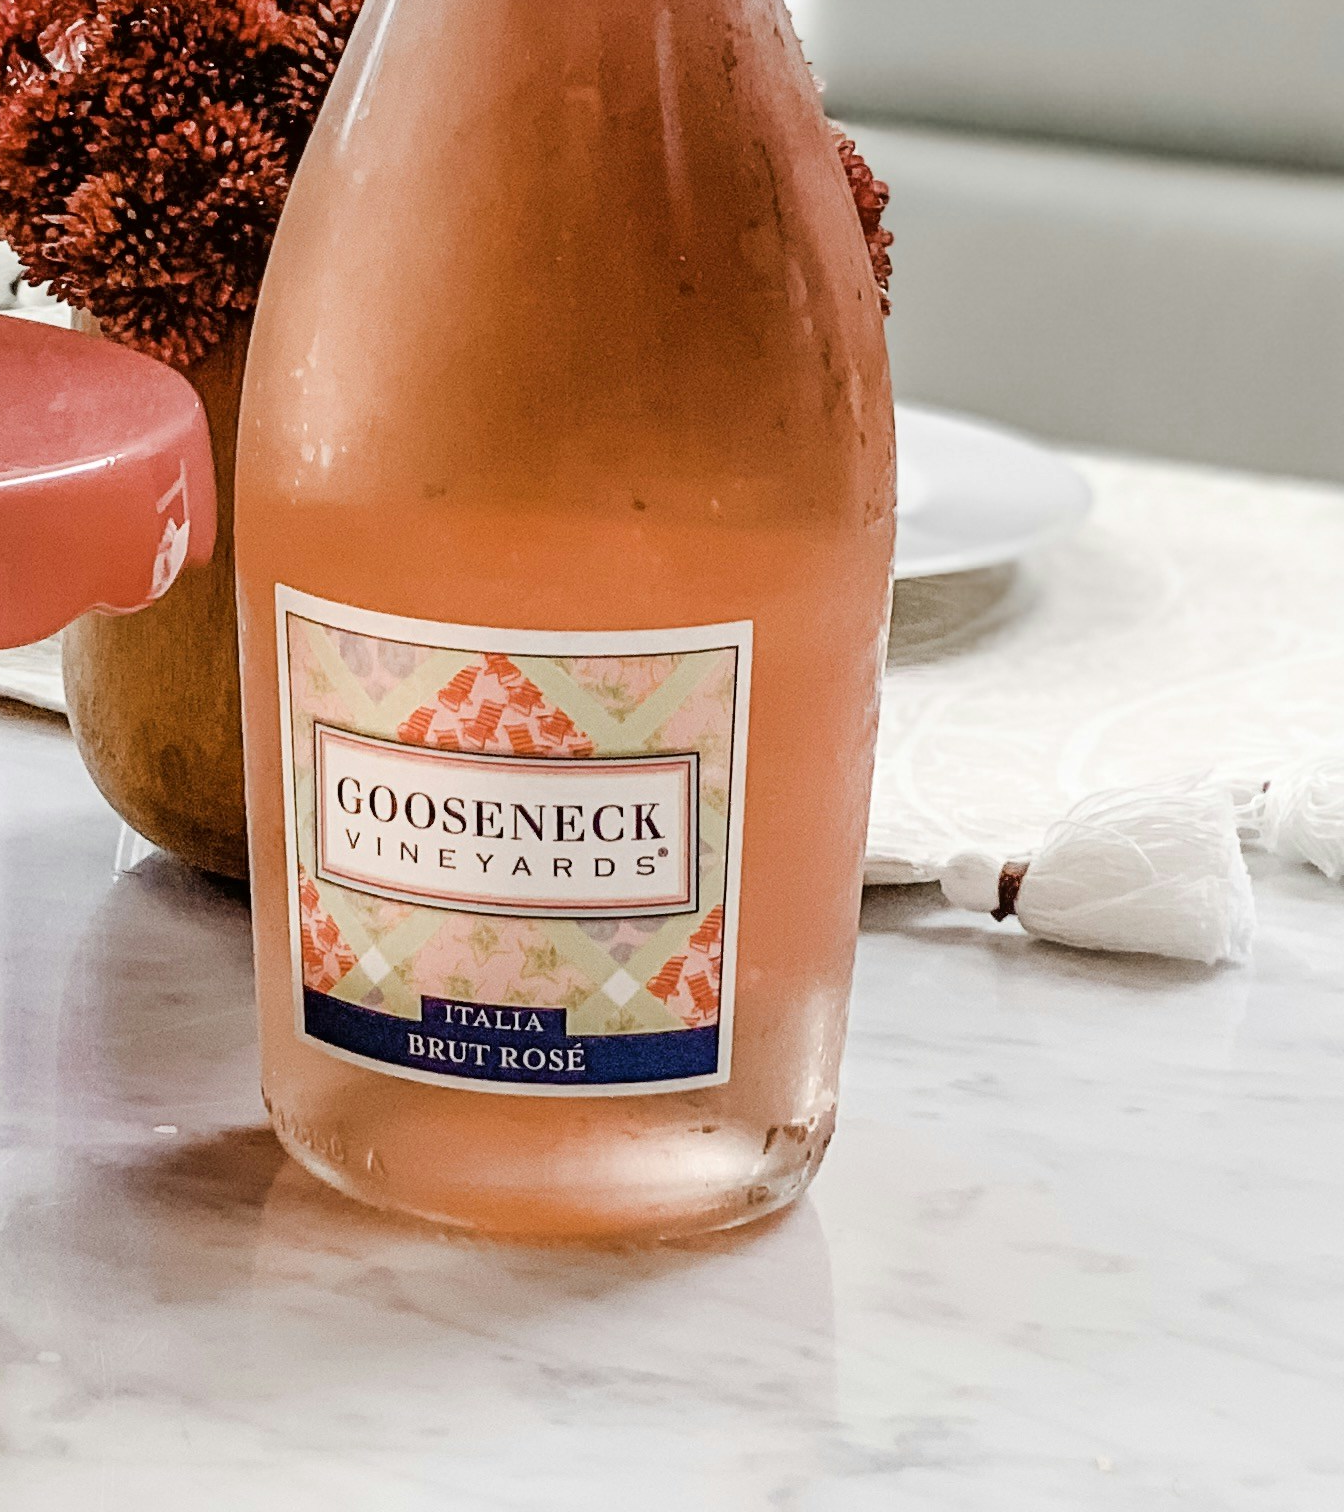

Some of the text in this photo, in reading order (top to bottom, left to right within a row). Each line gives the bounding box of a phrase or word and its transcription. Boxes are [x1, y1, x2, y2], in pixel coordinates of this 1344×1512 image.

[336, 775, 666, 843] GOOSENECK
[444, 1003, 545, 1033] ITALIA
[407, 1032, 587, 1072] BRUT ROSÉ
